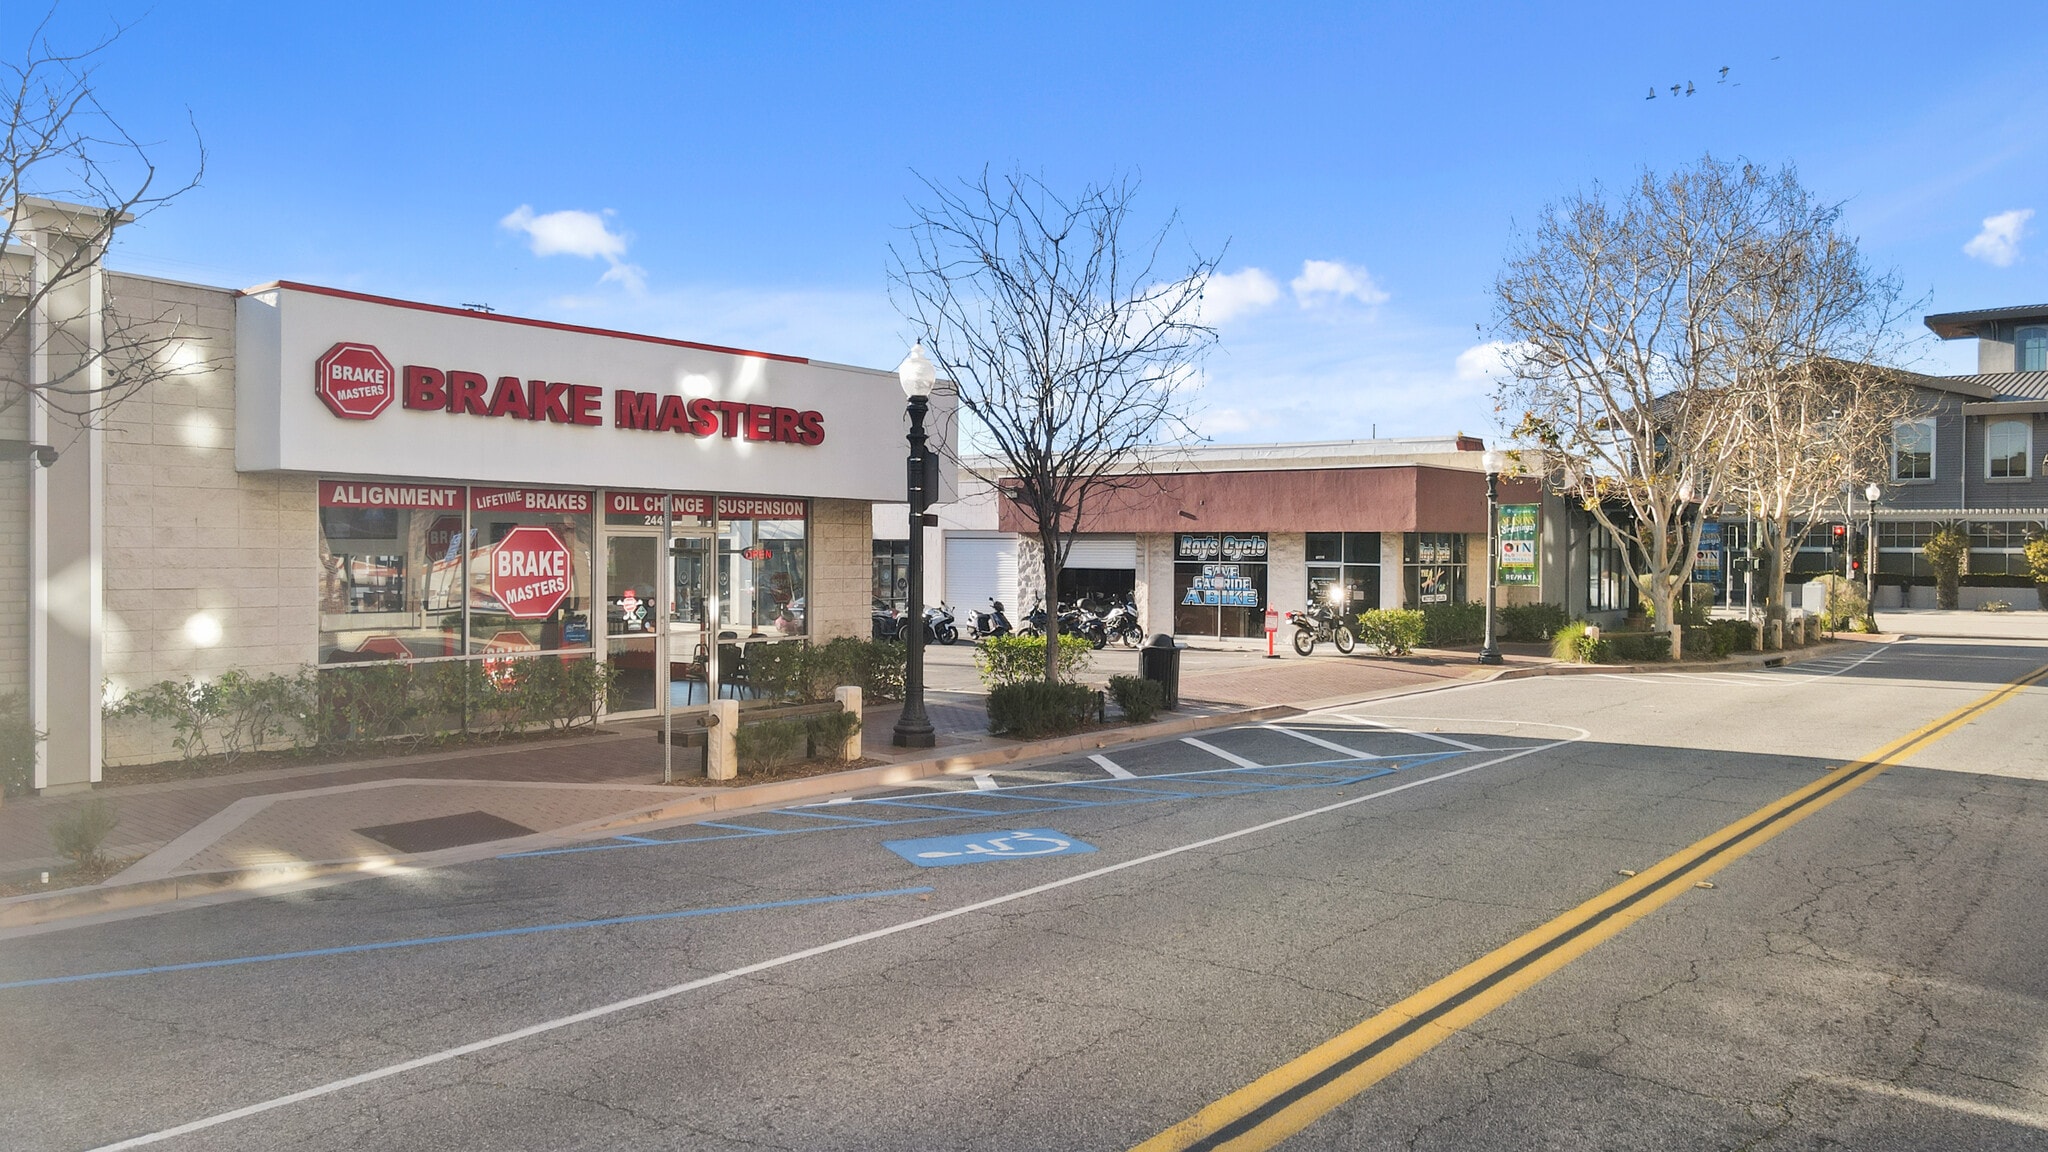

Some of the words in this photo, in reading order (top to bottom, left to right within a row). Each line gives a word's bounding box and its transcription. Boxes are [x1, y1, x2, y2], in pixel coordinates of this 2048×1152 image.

[331, 364, 385, 385] BRAKE
[336, 385, 385, 401] MASTERS
[402, 364, 602, 426] BRAKE
[614, 389, 826, 447] MASTERS
[331, 485, 457, 507] ALIGNMENT
[476, 490, 523, 509] LIFETIME
[525, 492, 588, 511] BRAKES
[613, 495, 640, 512] OIL
[643, 496, 704, 514] CHNGE
[718, 499, 804, 516] SUSPENSION
[644, 515, 665, 526] 244
[744, 549, 773, 560] OPEN
[1180, 535, 1220, 561] Roy's
[1222, 535, 1267, 561] Cycle
[498, 550, 565, 577] BRAKE
[1203, 565, 1239, 580] SAVE
[505, 577, 565, 605] MASTERS
[1223, 578, 1251, 591] RIDE
[1182, 588, 1204, 605] A
[1204, 589, 1258, 607] BIKE
